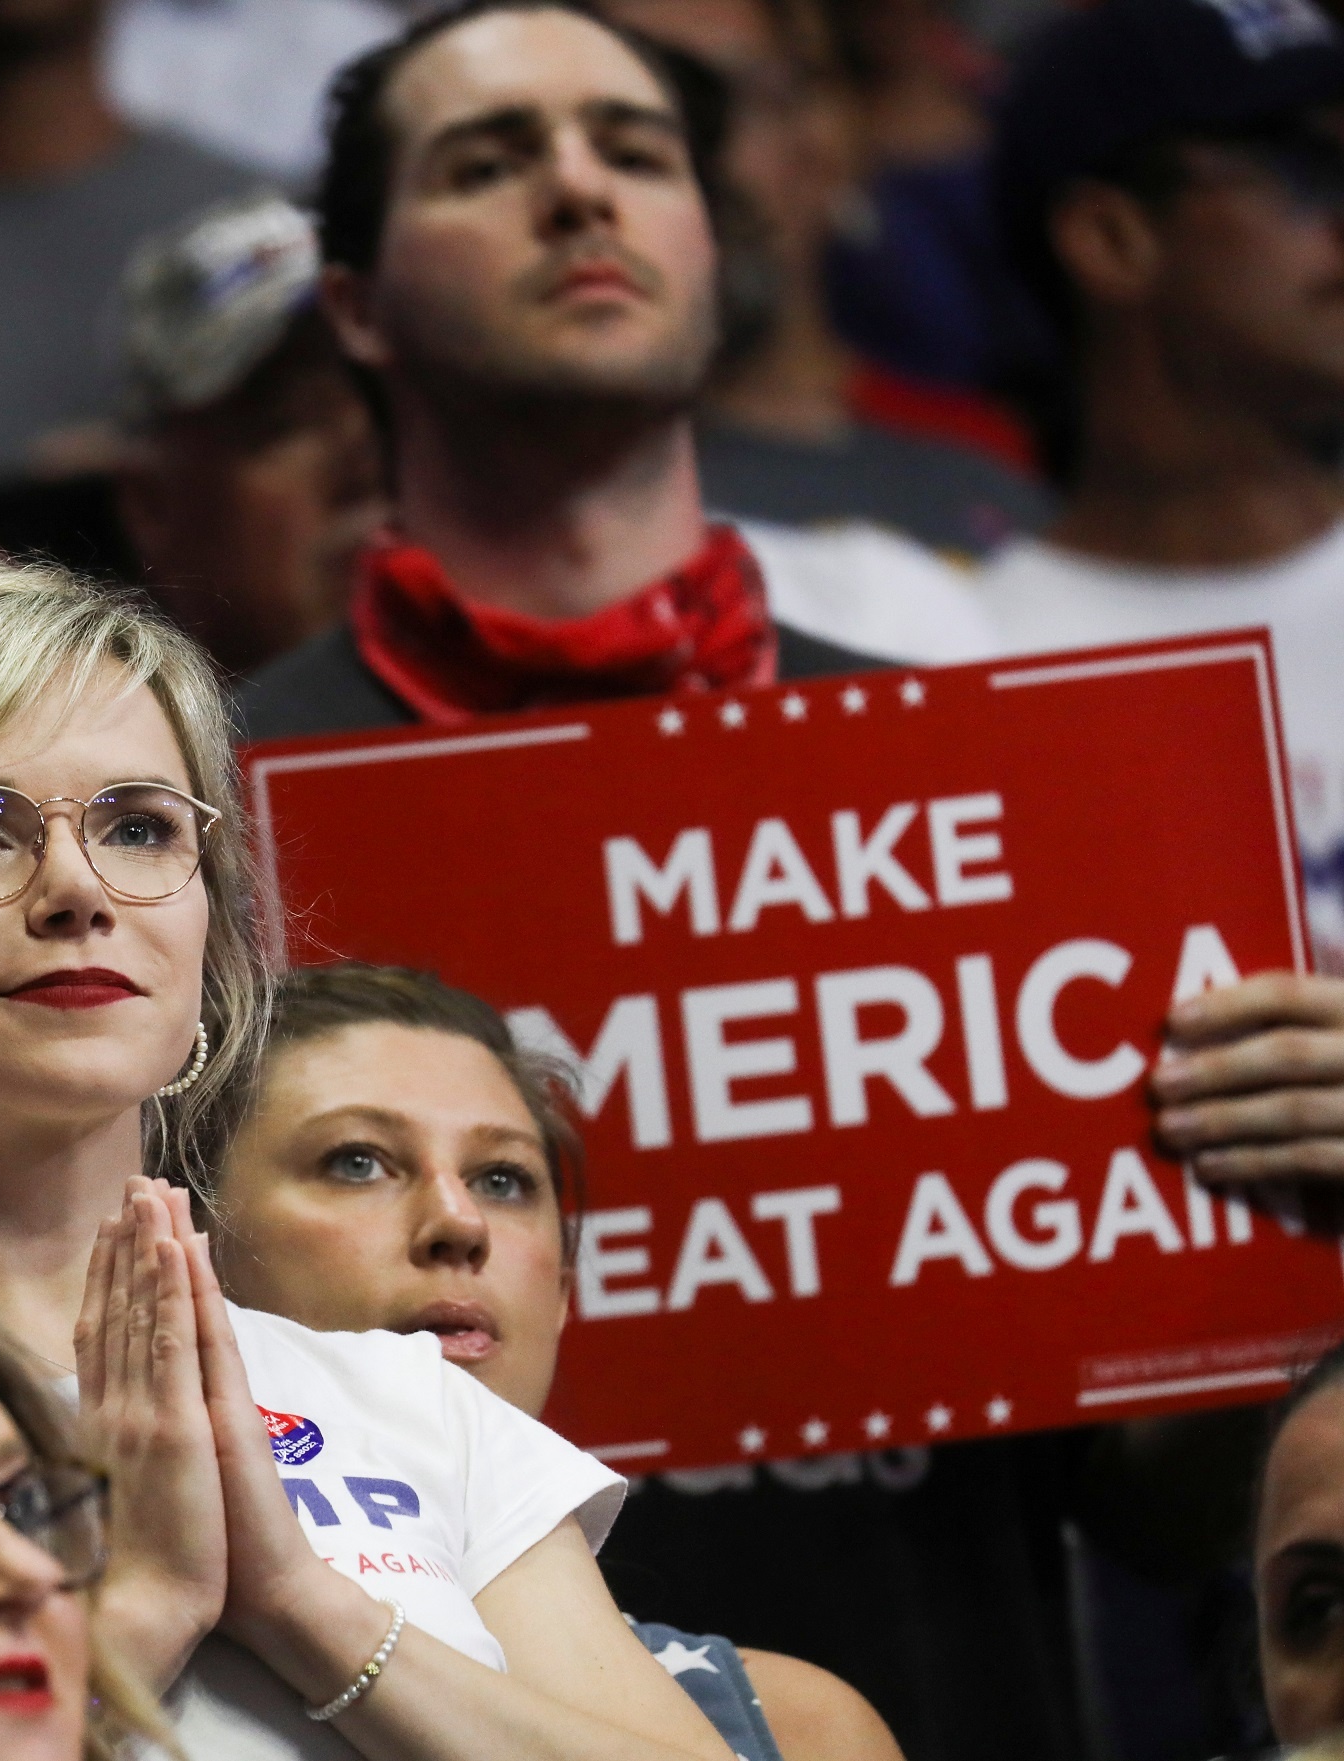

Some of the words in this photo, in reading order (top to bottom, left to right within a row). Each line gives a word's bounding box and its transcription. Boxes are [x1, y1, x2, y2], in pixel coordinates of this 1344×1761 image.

[603, 791, 1014, 946] MAKE
[568, 1185, 842, 1320] EAT
[358, 1553, 456, 1586] AGAIN
